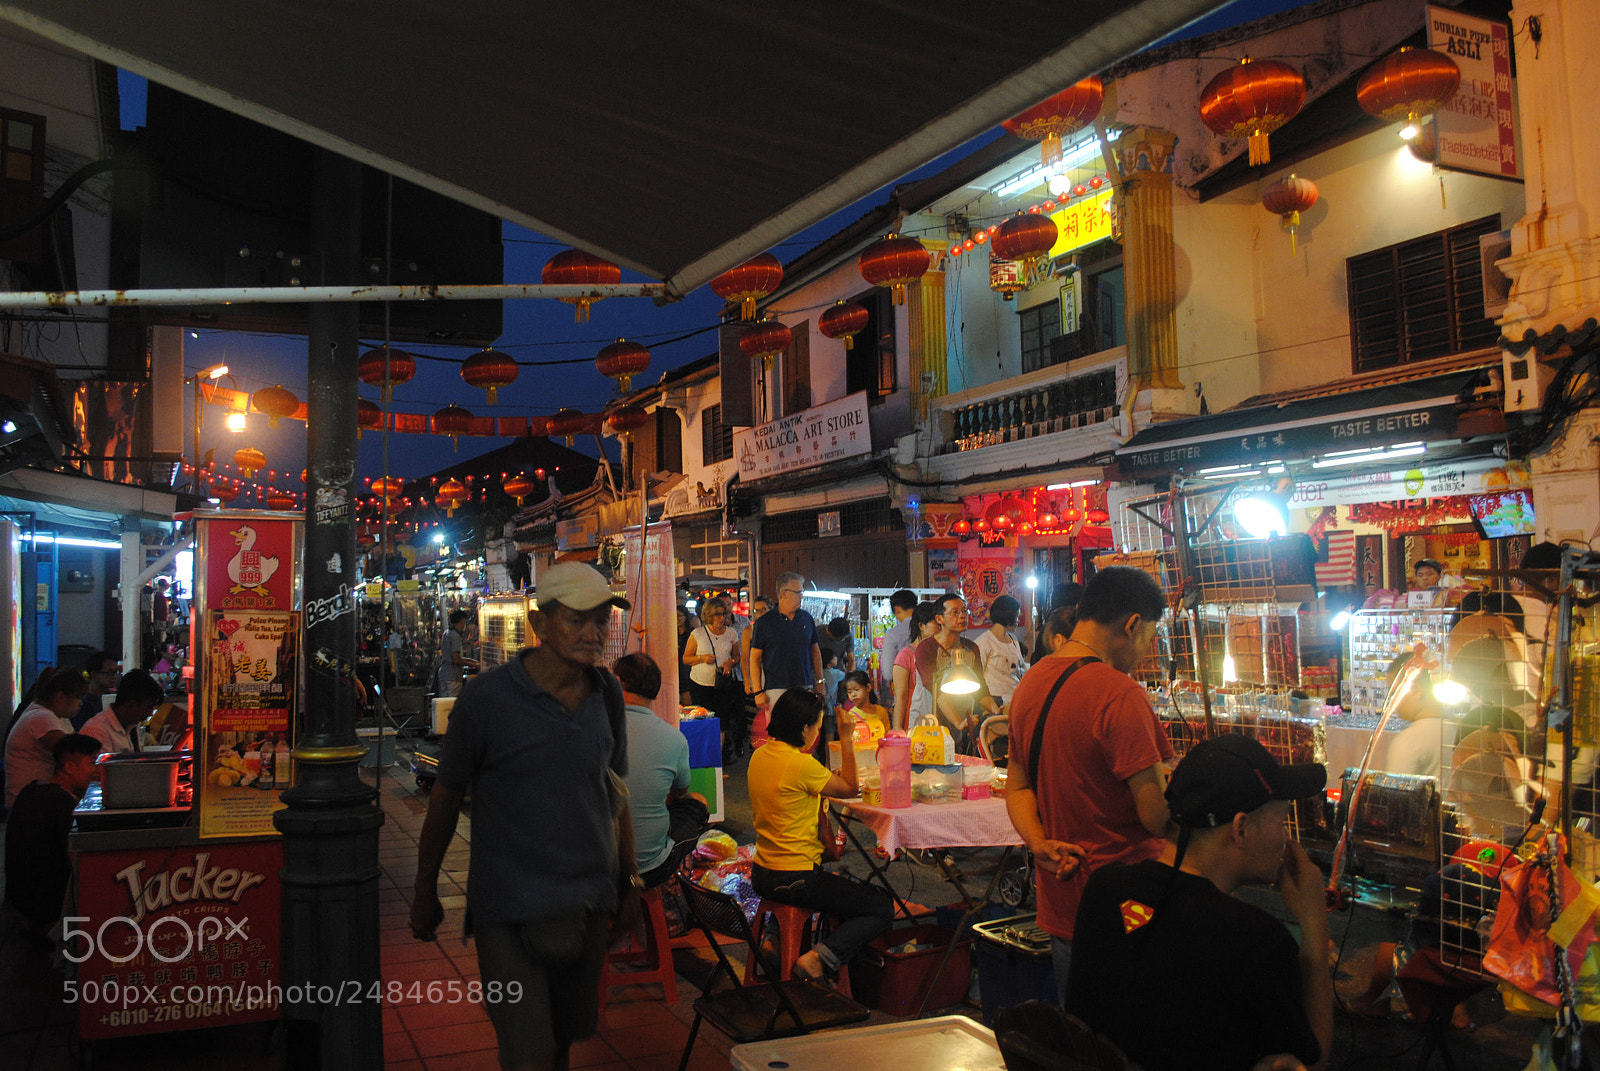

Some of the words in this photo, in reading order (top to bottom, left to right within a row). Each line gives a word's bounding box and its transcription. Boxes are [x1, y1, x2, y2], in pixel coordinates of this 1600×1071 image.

[1434, 20, 1467, 39] DURIAN
[1469, 30, 1491, 44] PUFF
[1447, 36, 1481, 60] ASLI
[754, 425, 776, 439] KEDAI
[780, 415, 803, 431] ANTIK
[755, 430, 799, 453] MALACCA
[803, 421, 823, 441] ART
[827, 409, 864, 433] STORE
[1331, 420, 1371, 439] TASTE
[1376, 411, 1431, 433] BETTER
[1131, 451, 1161, 466] TASTE
[1163, 445, 1201, 463] BETTER
[240, 571, 261, 583] 999
[982, 570, 999, 596] 福
[114, 852, 267, 925] Jacker
[194, 905, 231, 915] CRISPS
[100, 1005, 182, 1027] +6010-276
[184, 1000, 223, 1019] 0764
